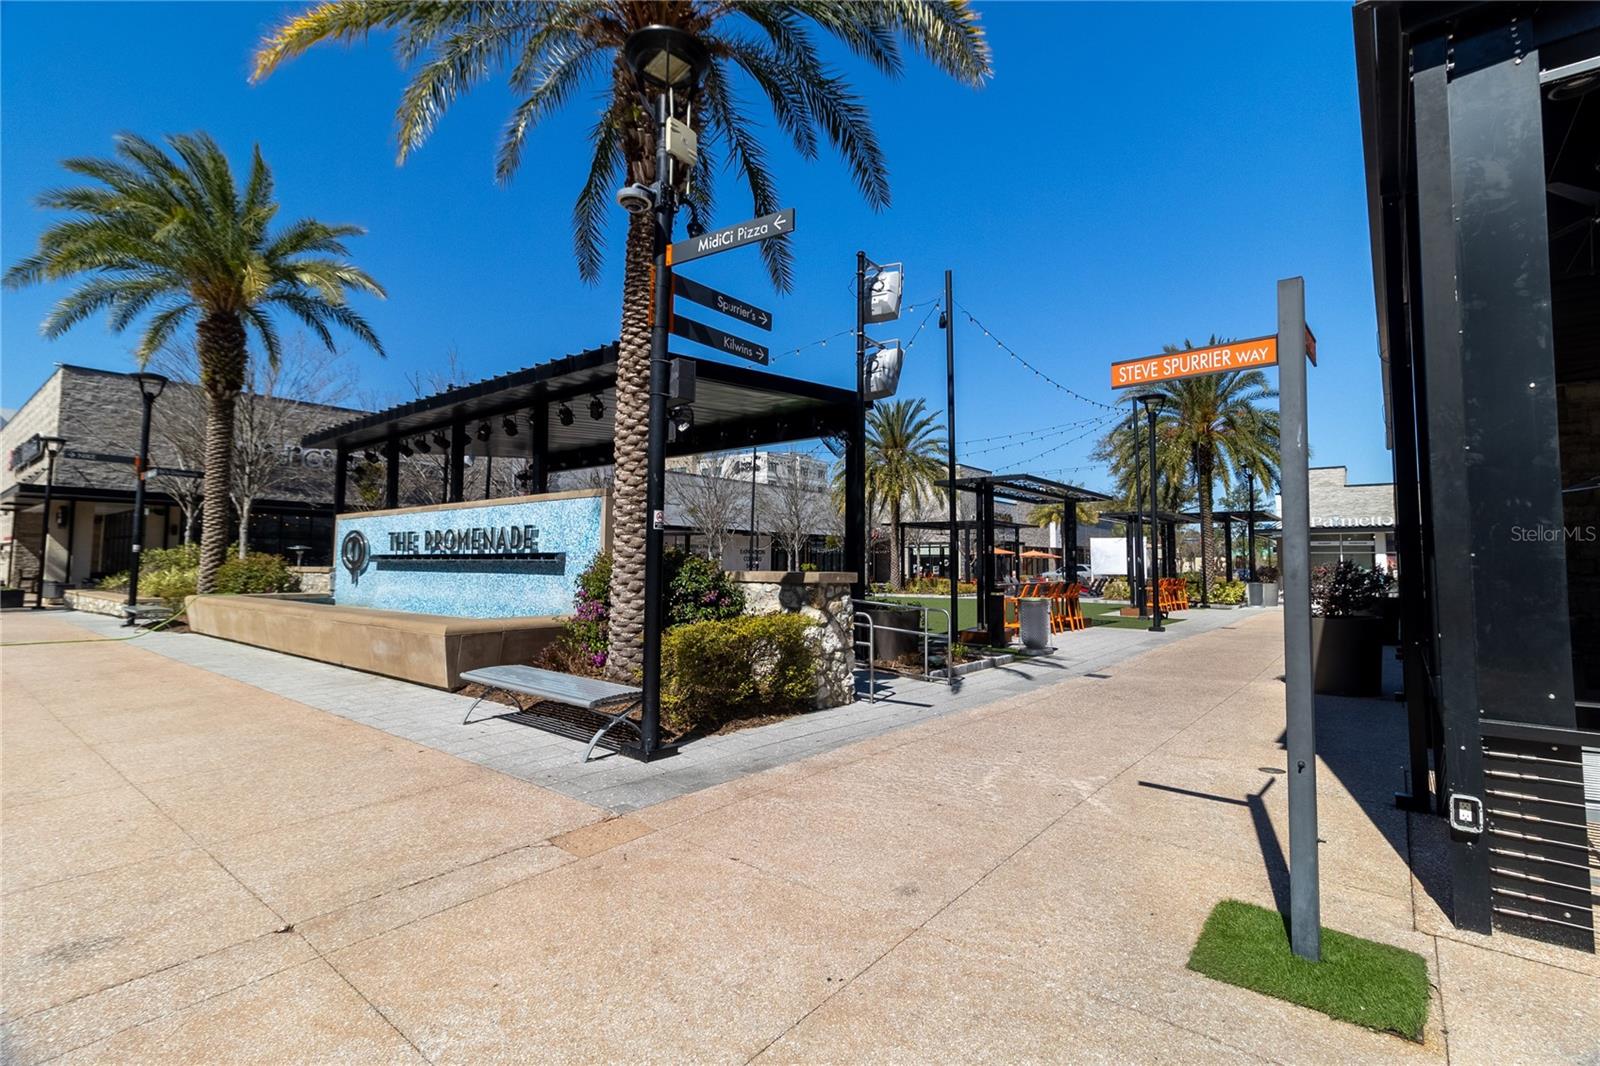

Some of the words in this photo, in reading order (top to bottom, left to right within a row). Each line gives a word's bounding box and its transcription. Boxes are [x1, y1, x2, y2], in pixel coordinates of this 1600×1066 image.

[697, 231, 735, 252] MidiCi
[737, 224, 769, 241] Pizza
[717, 295, 756, 321] Spurrier's
[723, 335, 753, 357] Kilwins
[1119, 361, 1159, 383] STEVE
[1163, 350, 1231, 376] SPURRIER
[1236, 347, 1269, 363] WAY
[388, 531, 418, 552] THE
[424, 525, 538, 551] PROMENADE
